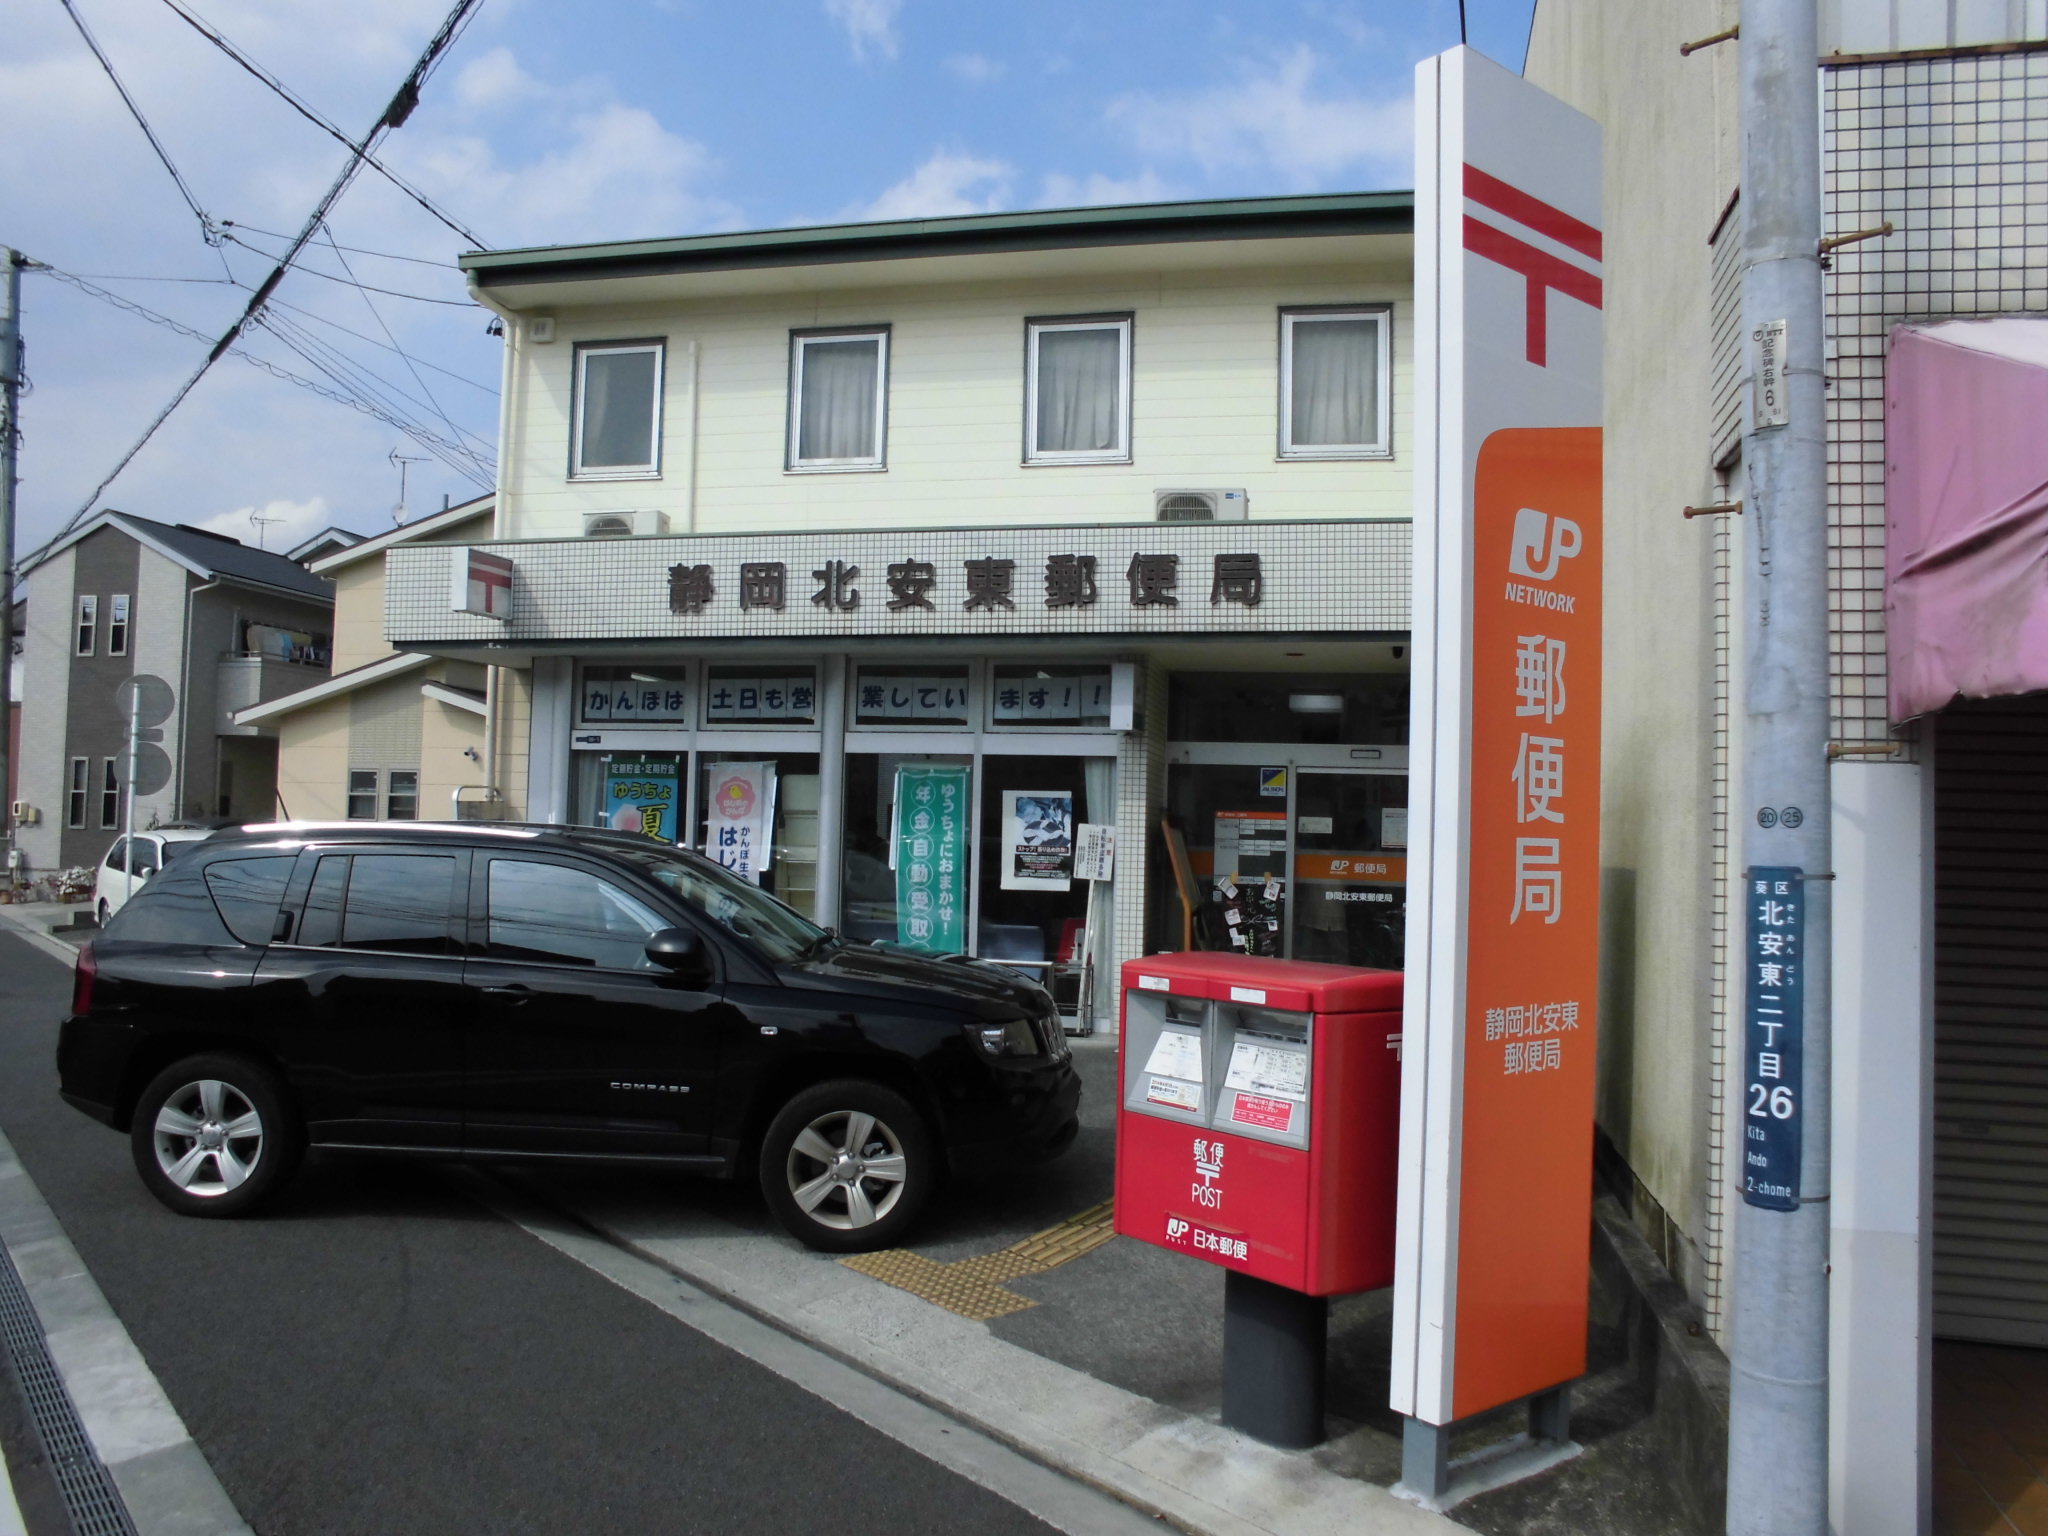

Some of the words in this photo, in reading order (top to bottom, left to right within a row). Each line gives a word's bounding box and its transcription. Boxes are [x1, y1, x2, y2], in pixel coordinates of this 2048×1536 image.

[668, 552, 1263, 613] 静岡北安東郵便局
[1505, 582, 1576, 614] NETWORK
[712, 687, 812, 709] 土日も営
[862, 685, 966, 709] 業してい
[614, 782, 672, 800] ゆうちょ
[1510, 634, 1566, 925] 郵便局
[637, 803, 672, 843] 夏
[910, 785, 931, 937] 年金自動受取
[938, 784, 955, 935] ゆうちょにおまかせ！
[1354, 863, 1387, 874] 郵便局
[1755, 881, 1789, 895] 葵区
[1485, 1000, 1579, 1041] 静岡北安東
[1504, 1038, 1560, 1075] 郵便局
[610, 1082, 690, 1093] COMPASS
[1749, 1083, 1793, 1119] 26
[1748, 1125, 1765, 1141] Kita
[1193, 1138, 1224, 1167] 郵便
[1748, 1151, 1767, 1167] Ando
[1192, 1183, 1223, 1210] POST
[1748, 1177, 1791, 1197] 2-chome
[1194, 1229, 1248, 1261] 日本郵便
